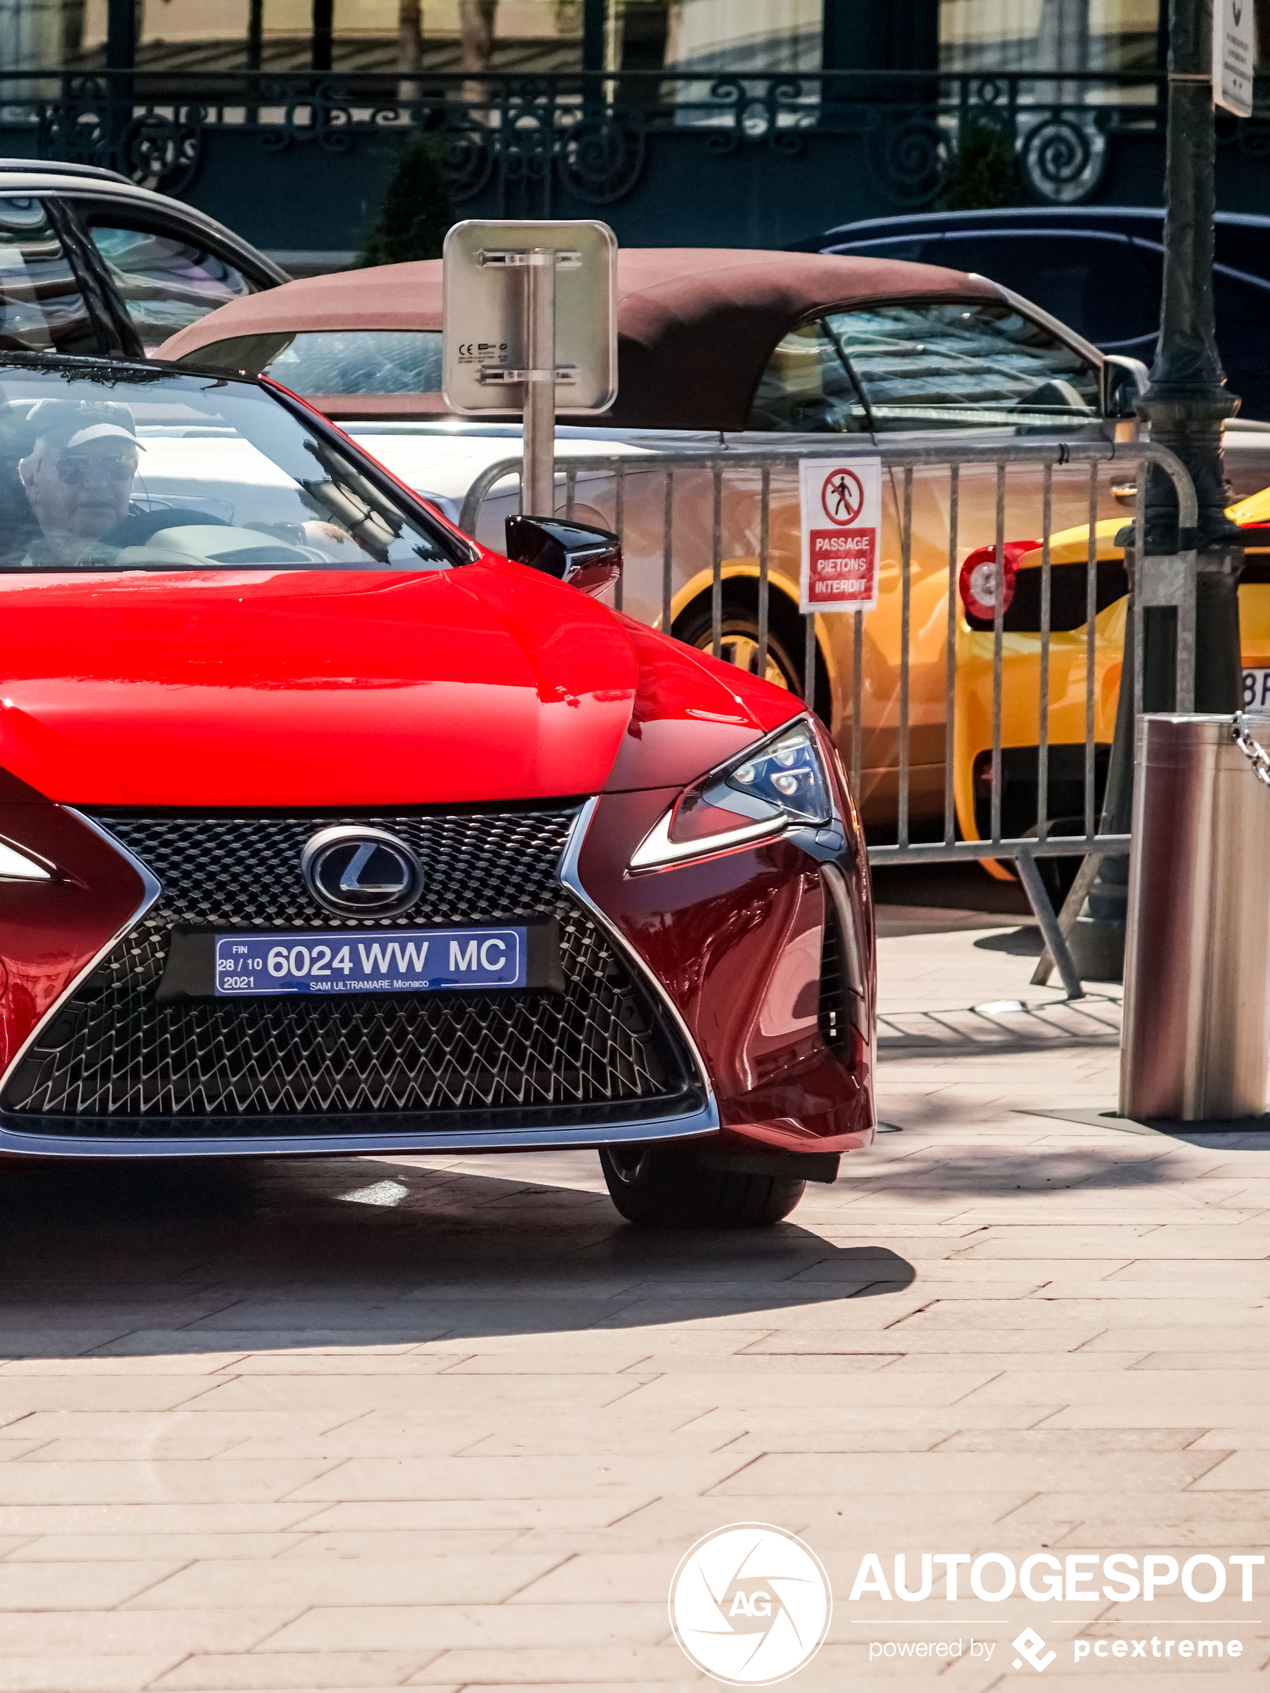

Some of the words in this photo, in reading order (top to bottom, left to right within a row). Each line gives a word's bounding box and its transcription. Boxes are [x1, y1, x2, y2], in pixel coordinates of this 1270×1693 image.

[815, 536, 870, 551] PASSAGE
[817, 557, 867, 572] PIETONS
[815, 578, 867, 594] INTERDIT
[232, 945, 248, 954] FIN
[218, 959, 235, 971] 28
[246, 957, 263, 970] 10
[267, 945, 353, 977] 6024
[358, 941, 430, 974] WW
[449, 938, 506, 972] MC
[223, 976, 255, 988] 2021
[310, 981, 331, 991] SAM
[333, 979, 391, 990] ULTRAMARE
[393, 979, 429, 988] Monaco
